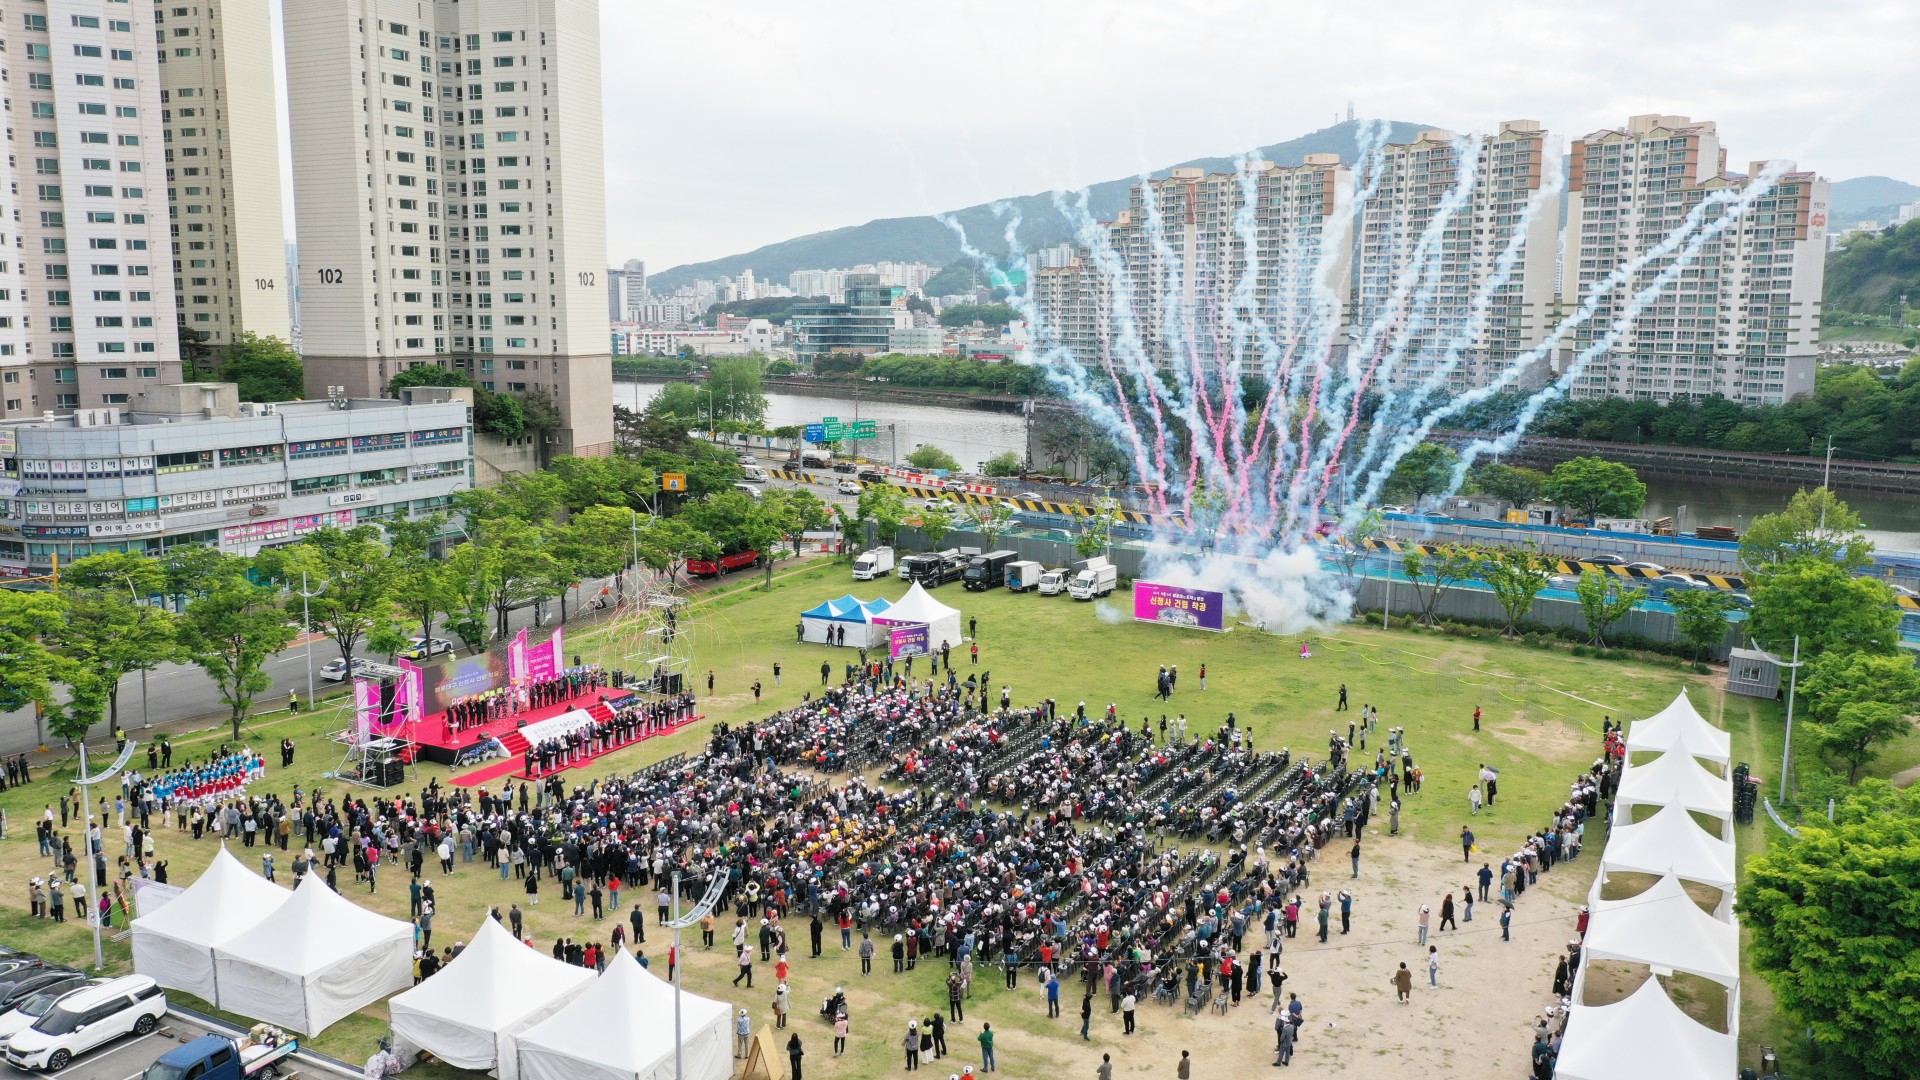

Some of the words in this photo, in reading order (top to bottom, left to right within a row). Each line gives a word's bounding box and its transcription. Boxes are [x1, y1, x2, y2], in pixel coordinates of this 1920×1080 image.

[254, 278, 275, 290] 104
[317, 268, 343, 284] 102
[578, 271, 595, 287] 102
[1150, 596, 1172, 607] 신청사
[1174, 599, 1189, 609] 건립
[1192, 601, 1207, 612] 착공
